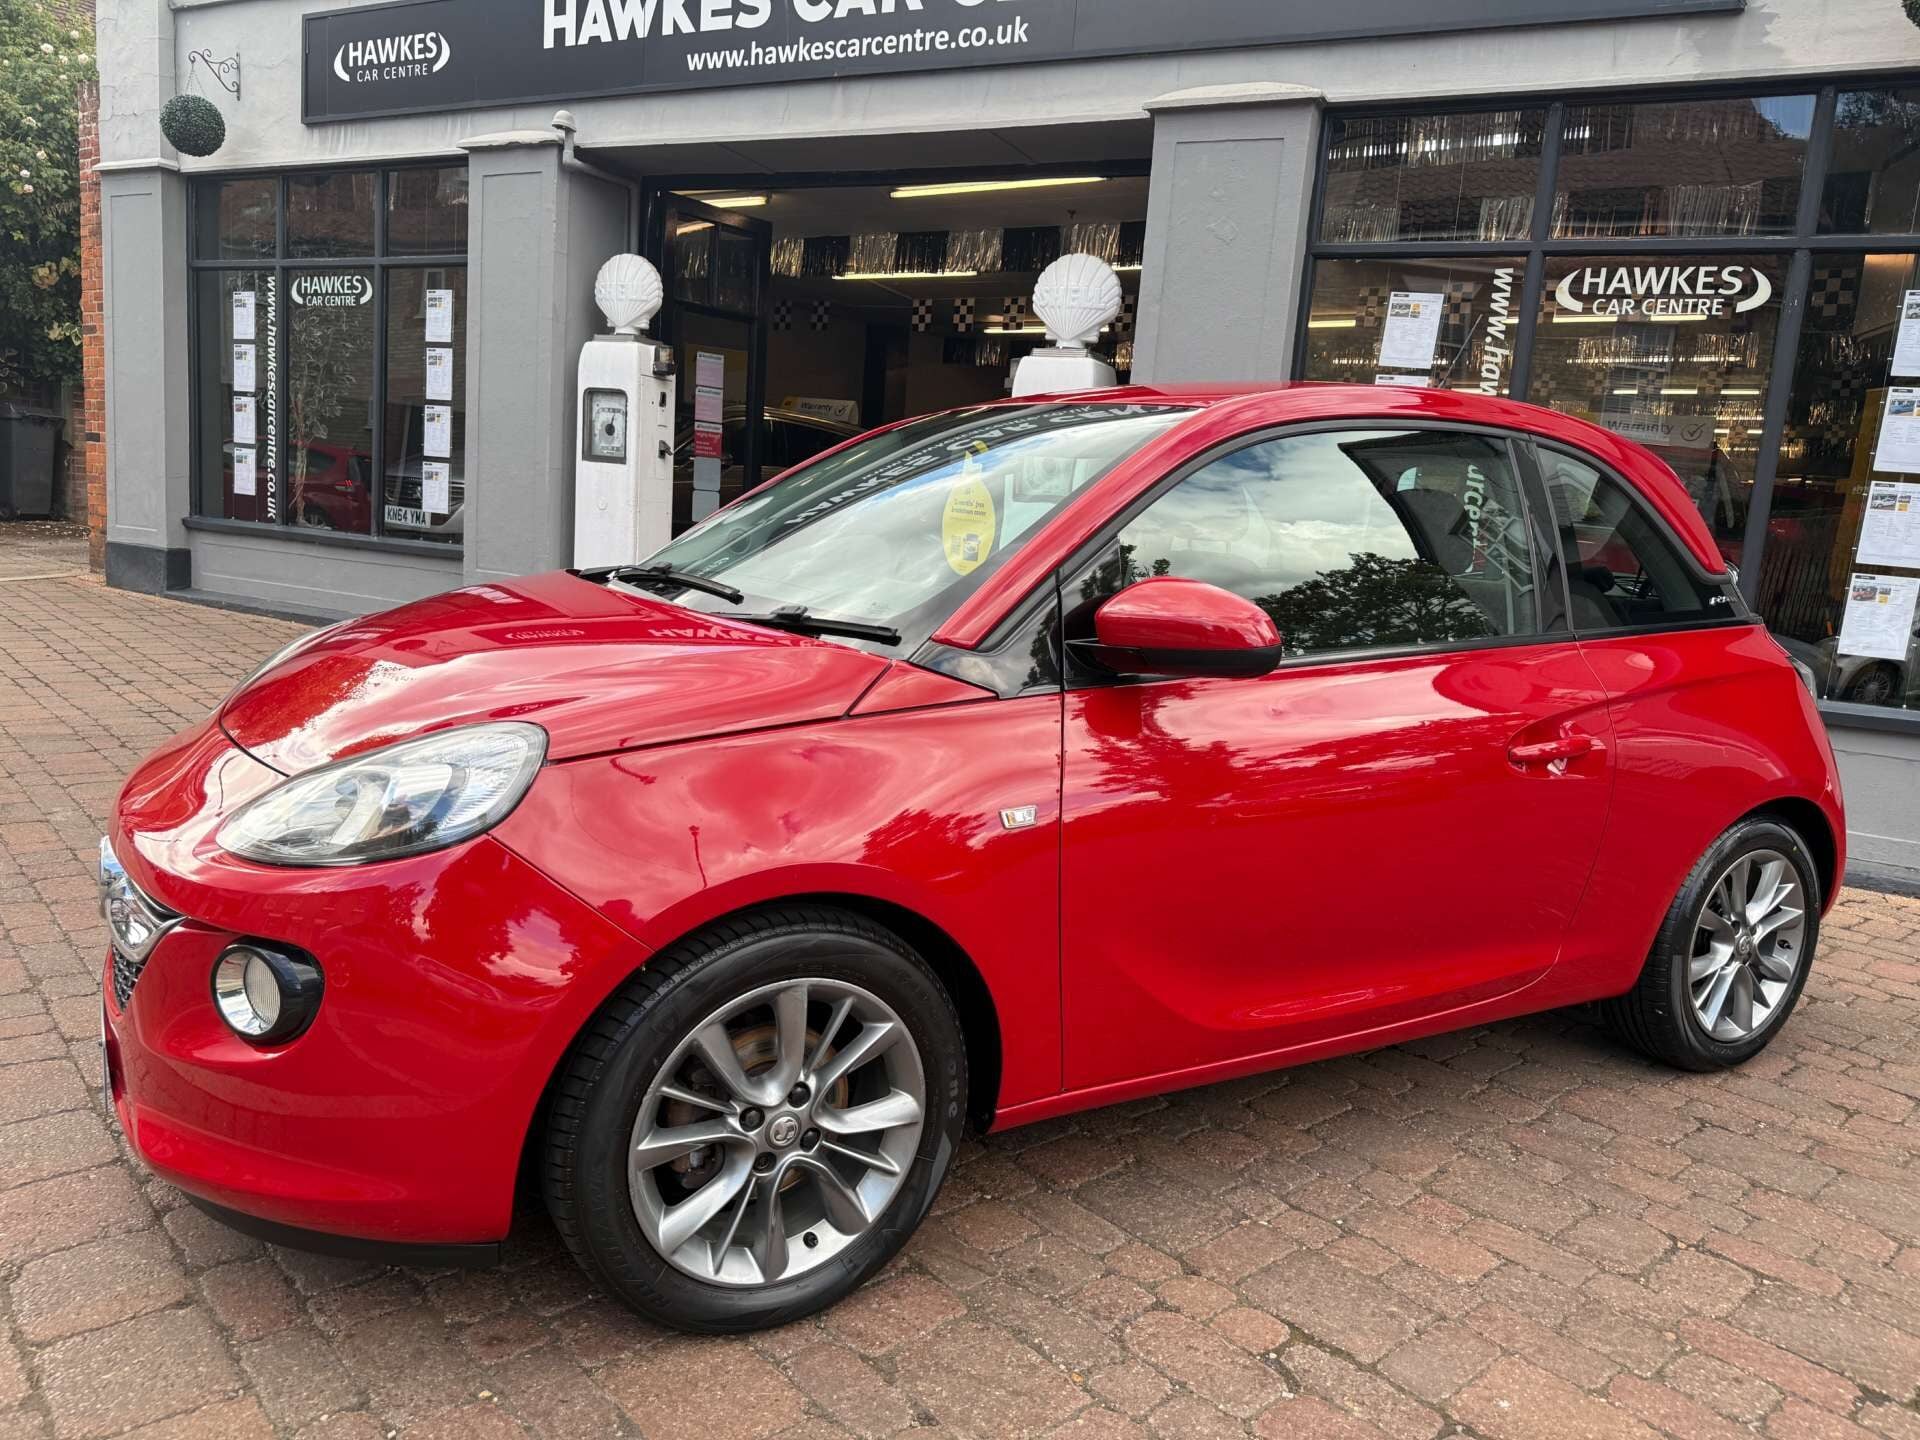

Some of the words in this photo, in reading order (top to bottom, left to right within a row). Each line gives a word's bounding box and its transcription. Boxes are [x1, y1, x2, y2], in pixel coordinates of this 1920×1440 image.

[543, 0, 772, 49] HAWKES
[348, 31, 438, 67] HAWKES
[686, 16, 1029, 71] www.hawkescarcentre.co.uk
[356, 68, 379, 82] CAR
[383, 63, 429, 79] CENTRE
[301, 275, 363, 294] HAWKES
[1582, 265, 1745, 296] HAWKES
[306, 295, 323, 307] CAR
[324, 295, 358, 307] CENTRE
[1592, 298, 1639, 316] CAR
[1641, 298, 1725, 316] CENTRE
[267, 276, 277, 519] www.hawkescarcentre.co.uk
